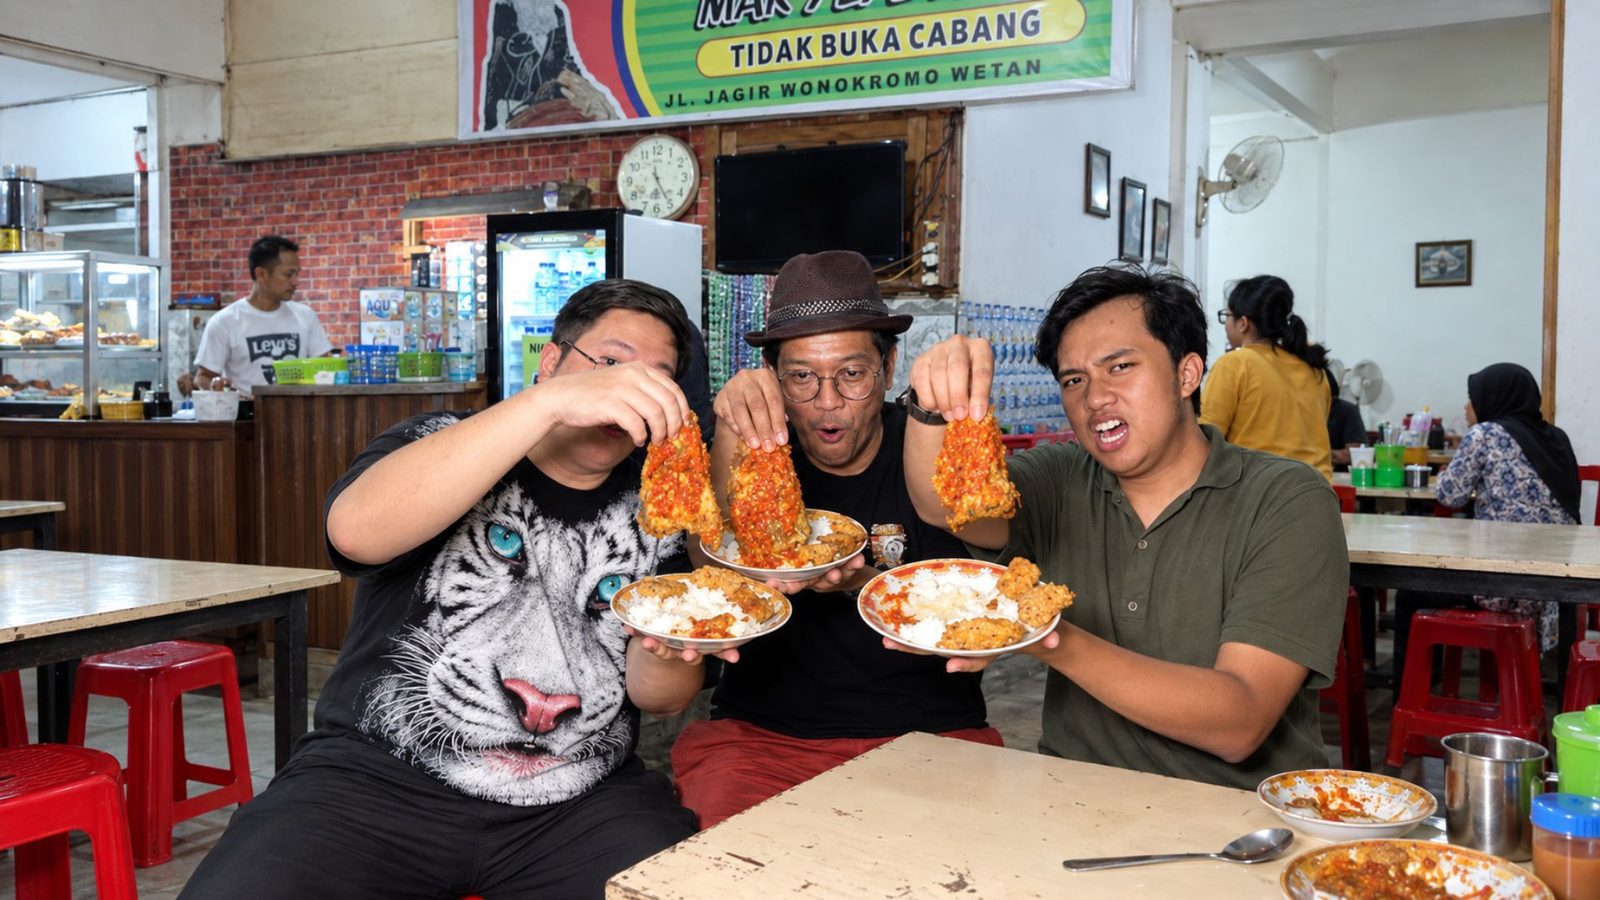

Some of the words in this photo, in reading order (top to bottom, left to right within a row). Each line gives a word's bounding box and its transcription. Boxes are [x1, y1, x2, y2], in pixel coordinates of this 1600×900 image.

[730, 35, 813, 68] TIDAK
[821, 26, 901, 59] BUKA
[909, 9, 1041, 49] CABANG
[664, 93, 695, 108] JL.
[704, 84, 770, 105] JAGIR
[780, 69, 939, 97] WONOKROMO
[951, 59, 1041, 82] WETAN
[641, 150, 649, 160] 11
[652, 145, 663, 156] 12
[669, 147, 673, 158] 1
[629, 162, 640, 172] 10
[677, 157, 684, 168] 2
[626, 176, 633, 187] 9
[681, 172, 688, 182] 3
[631, 191, 637, 201] 8
[676, 187, 684, 197] 4
[642, 201, 648, 211] 7
[653, 203, 660, 213] 6
[666, 199, 673, 209] 5
[529, 343, 544, 354] NI
